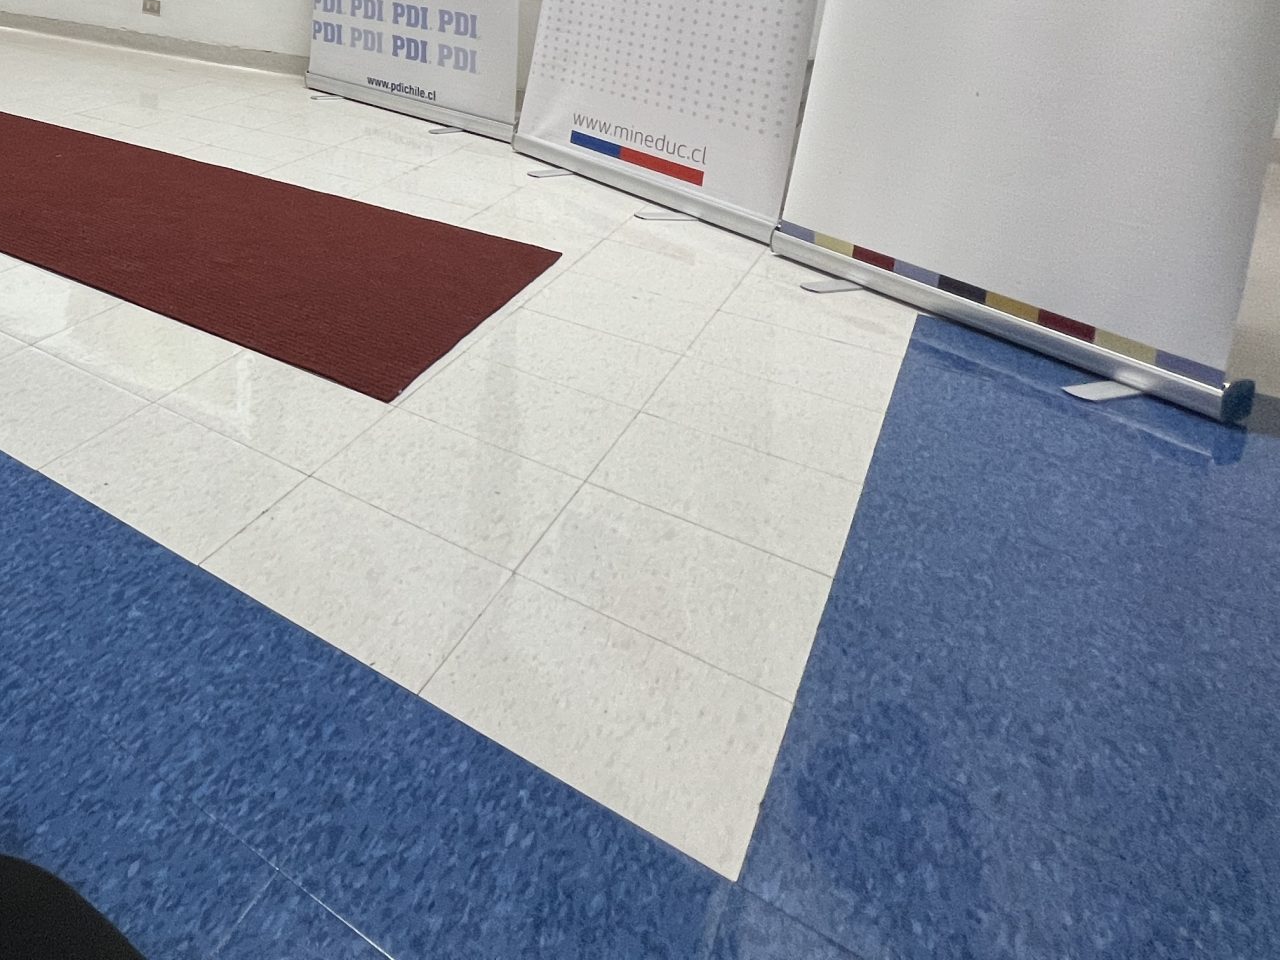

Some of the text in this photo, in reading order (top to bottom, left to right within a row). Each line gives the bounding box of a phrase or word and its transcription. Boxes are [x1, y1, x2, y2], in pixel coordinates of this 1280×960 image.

[392, 2, 429, 30] PDI
[438, 9, 478, 39] PDI
[312, 19, 478, 74] PDI PDI PDI PDI
[367, 76, 436, 101] www.pdichile.cl
[572, 112, 708, 165] www.mineduc.cl
